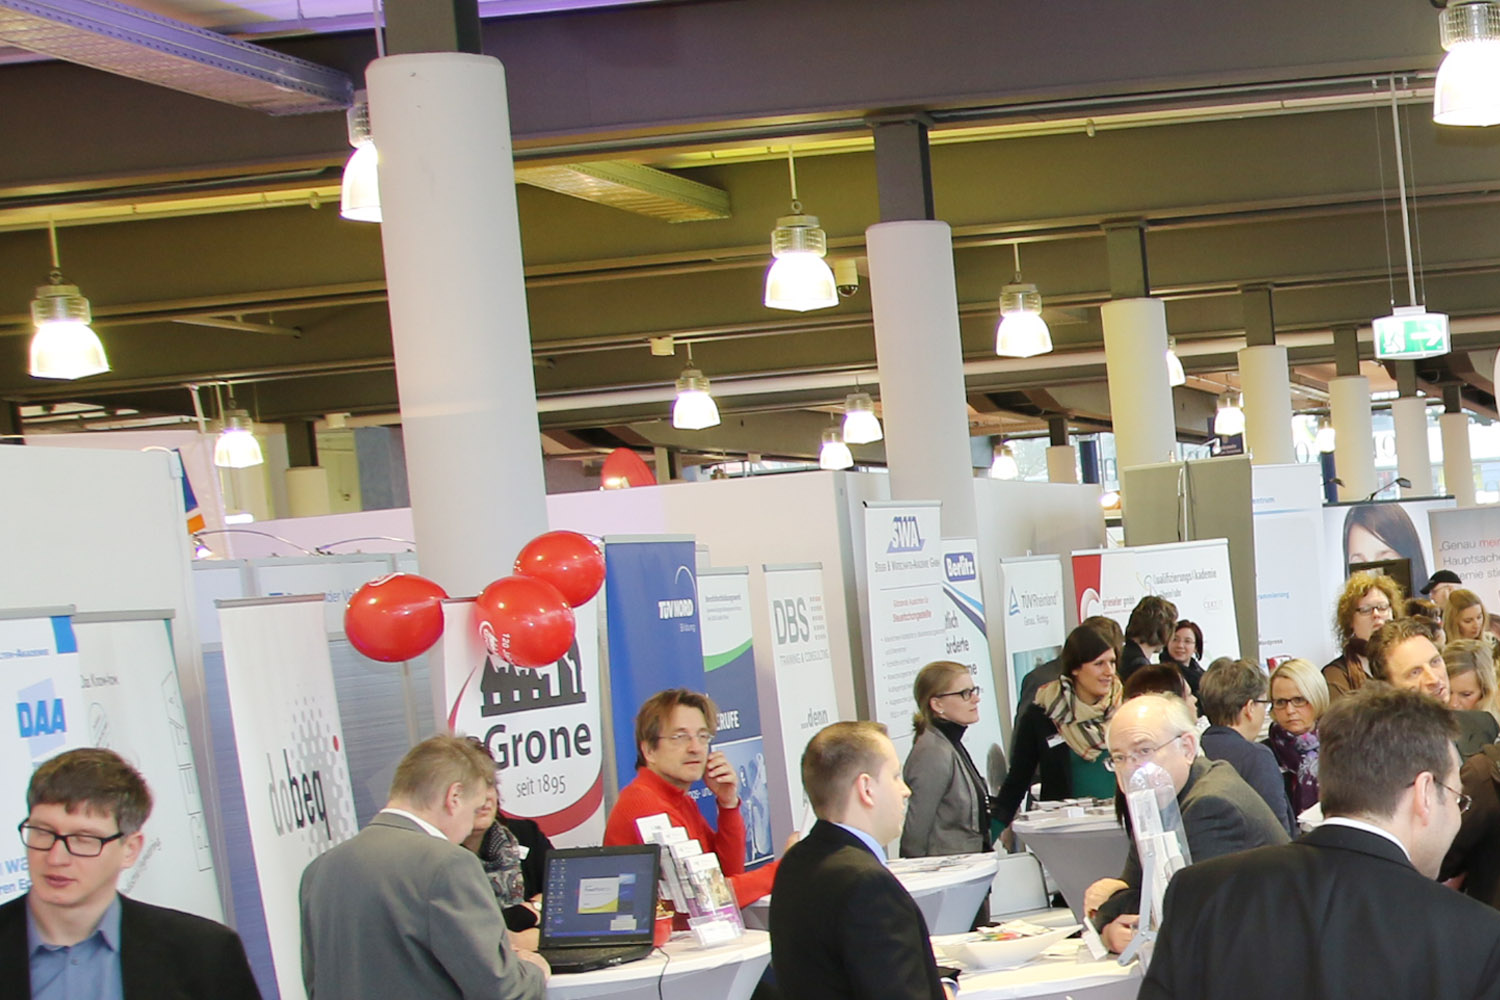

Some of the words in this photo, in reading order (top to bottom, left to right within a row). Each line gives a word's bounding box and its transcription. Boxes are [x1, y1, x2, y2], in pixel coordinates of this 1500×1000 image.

[891, 516, 920, 548] SWA
[946, 554, 975, 578] Berlitz
[1460, 569, 1484, 580] emie
[659, 601, 674, 620] TÜV
[673, 598, 694, 618] NORD
[773, 597, 810, 646] DBS
[16, 698, 68, 738] DAA
[484, 722, 592, 771] Grone
[265, 748, 332, 841] dobeq
[516, 778, 534, 798] seit
[536, 773, 567, 796] 1895
